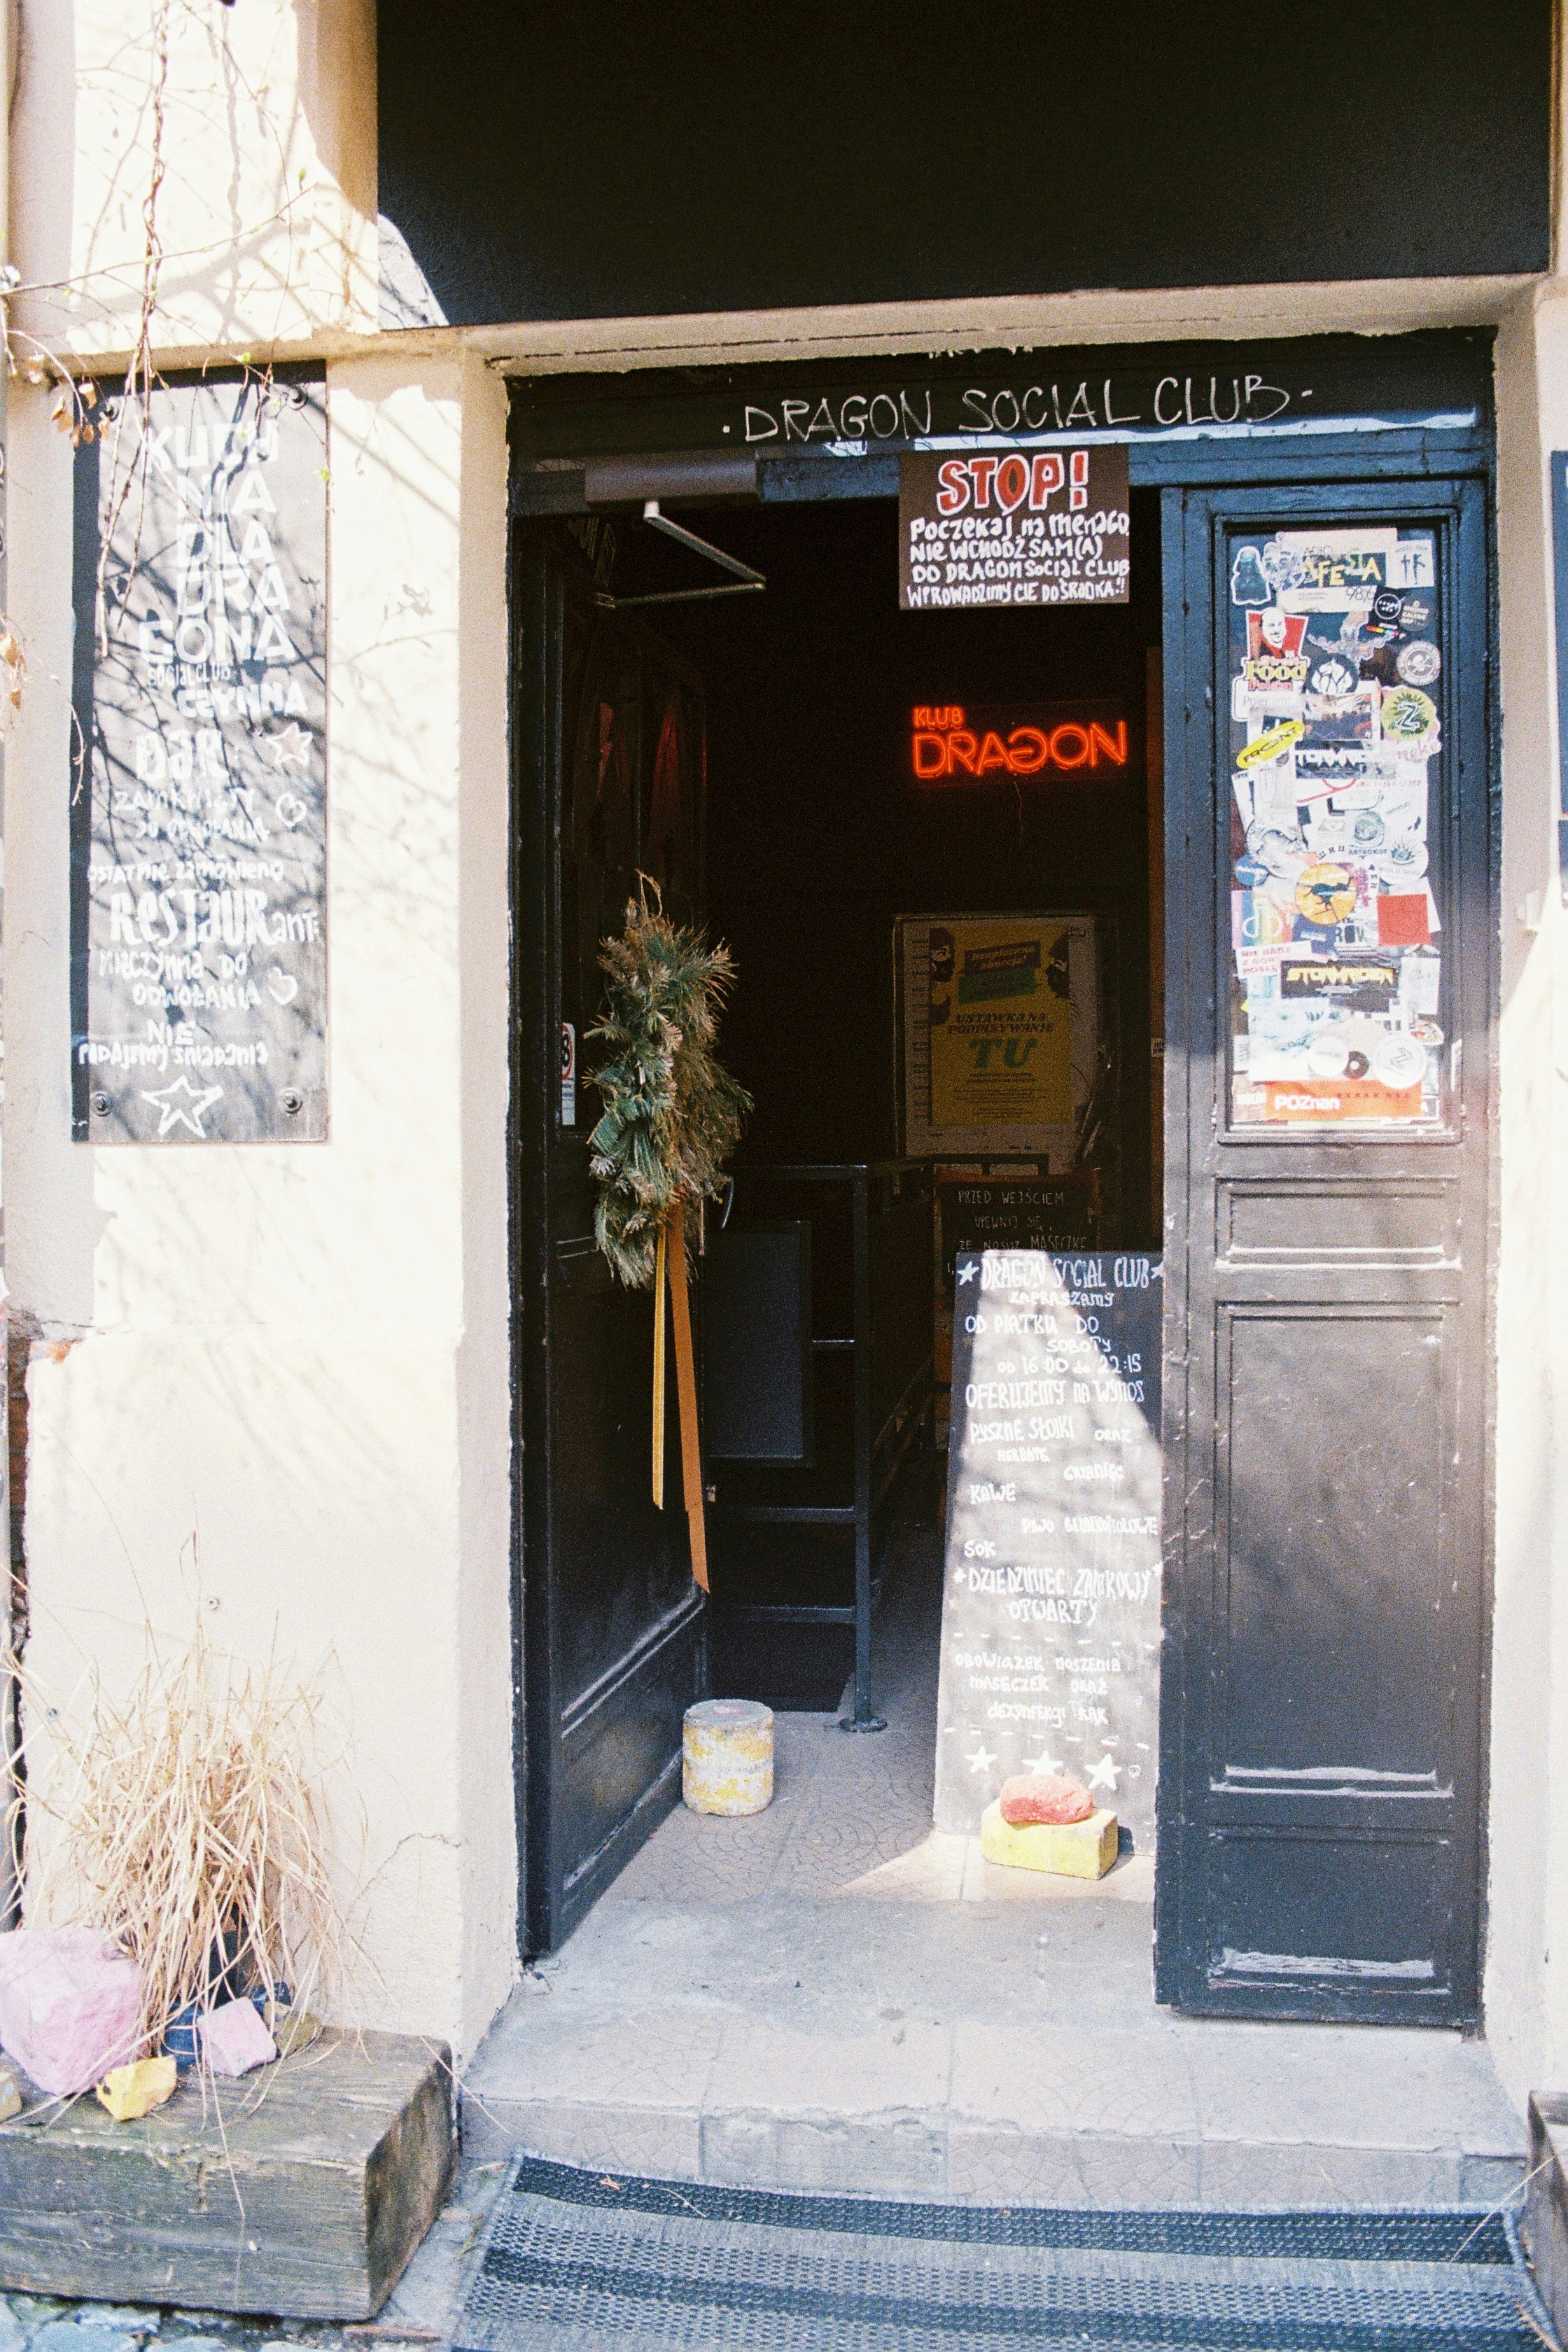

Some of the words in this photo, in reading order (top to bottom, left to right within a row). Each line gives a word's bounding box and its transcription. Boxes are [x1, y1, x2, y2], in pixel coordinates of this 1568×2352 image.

[745, 389, 931, 442] DRAGON
[958, 378, 1141, 432] SOCIAL
[1153, 374, 1291, 425] CLUB
[936, 450, 1089, 516] STOP!
[176, 519, 276, 567] DLA
[910, 516, 1013, 542] Poczekaj
[1021, 518, 1045, 537] na
[1028, 536, 1103, 560] SAM(A)
[912, 564, 940, 583] DO
[1084, 559, 1130, 577] CLUB
[176, 564, 290, 617] DRA
[913, 706, 965, 729] KLUB
[912, 720, 1128, 778] DRAGON
[218, 951, 248, 979] DO
[146, 1018, 197, 1046] NIE
[969, 1037, 1038, 1070] TU
[958, 1190, 993, 1204] PRZED
[1052, 1258, 1107, 1289] SOCIAL
[1114, 1256, 1150, 1289] CLUB
[965, 1315, 987, 1334] OD
[1074, 1315, 1100, 1334] DO
[1046, 1336, 1112, 1353] SOBOTY
[963, 1539, 997, 1558] SOK
[1008, 1597, 1098, 1627] OTWARTY
